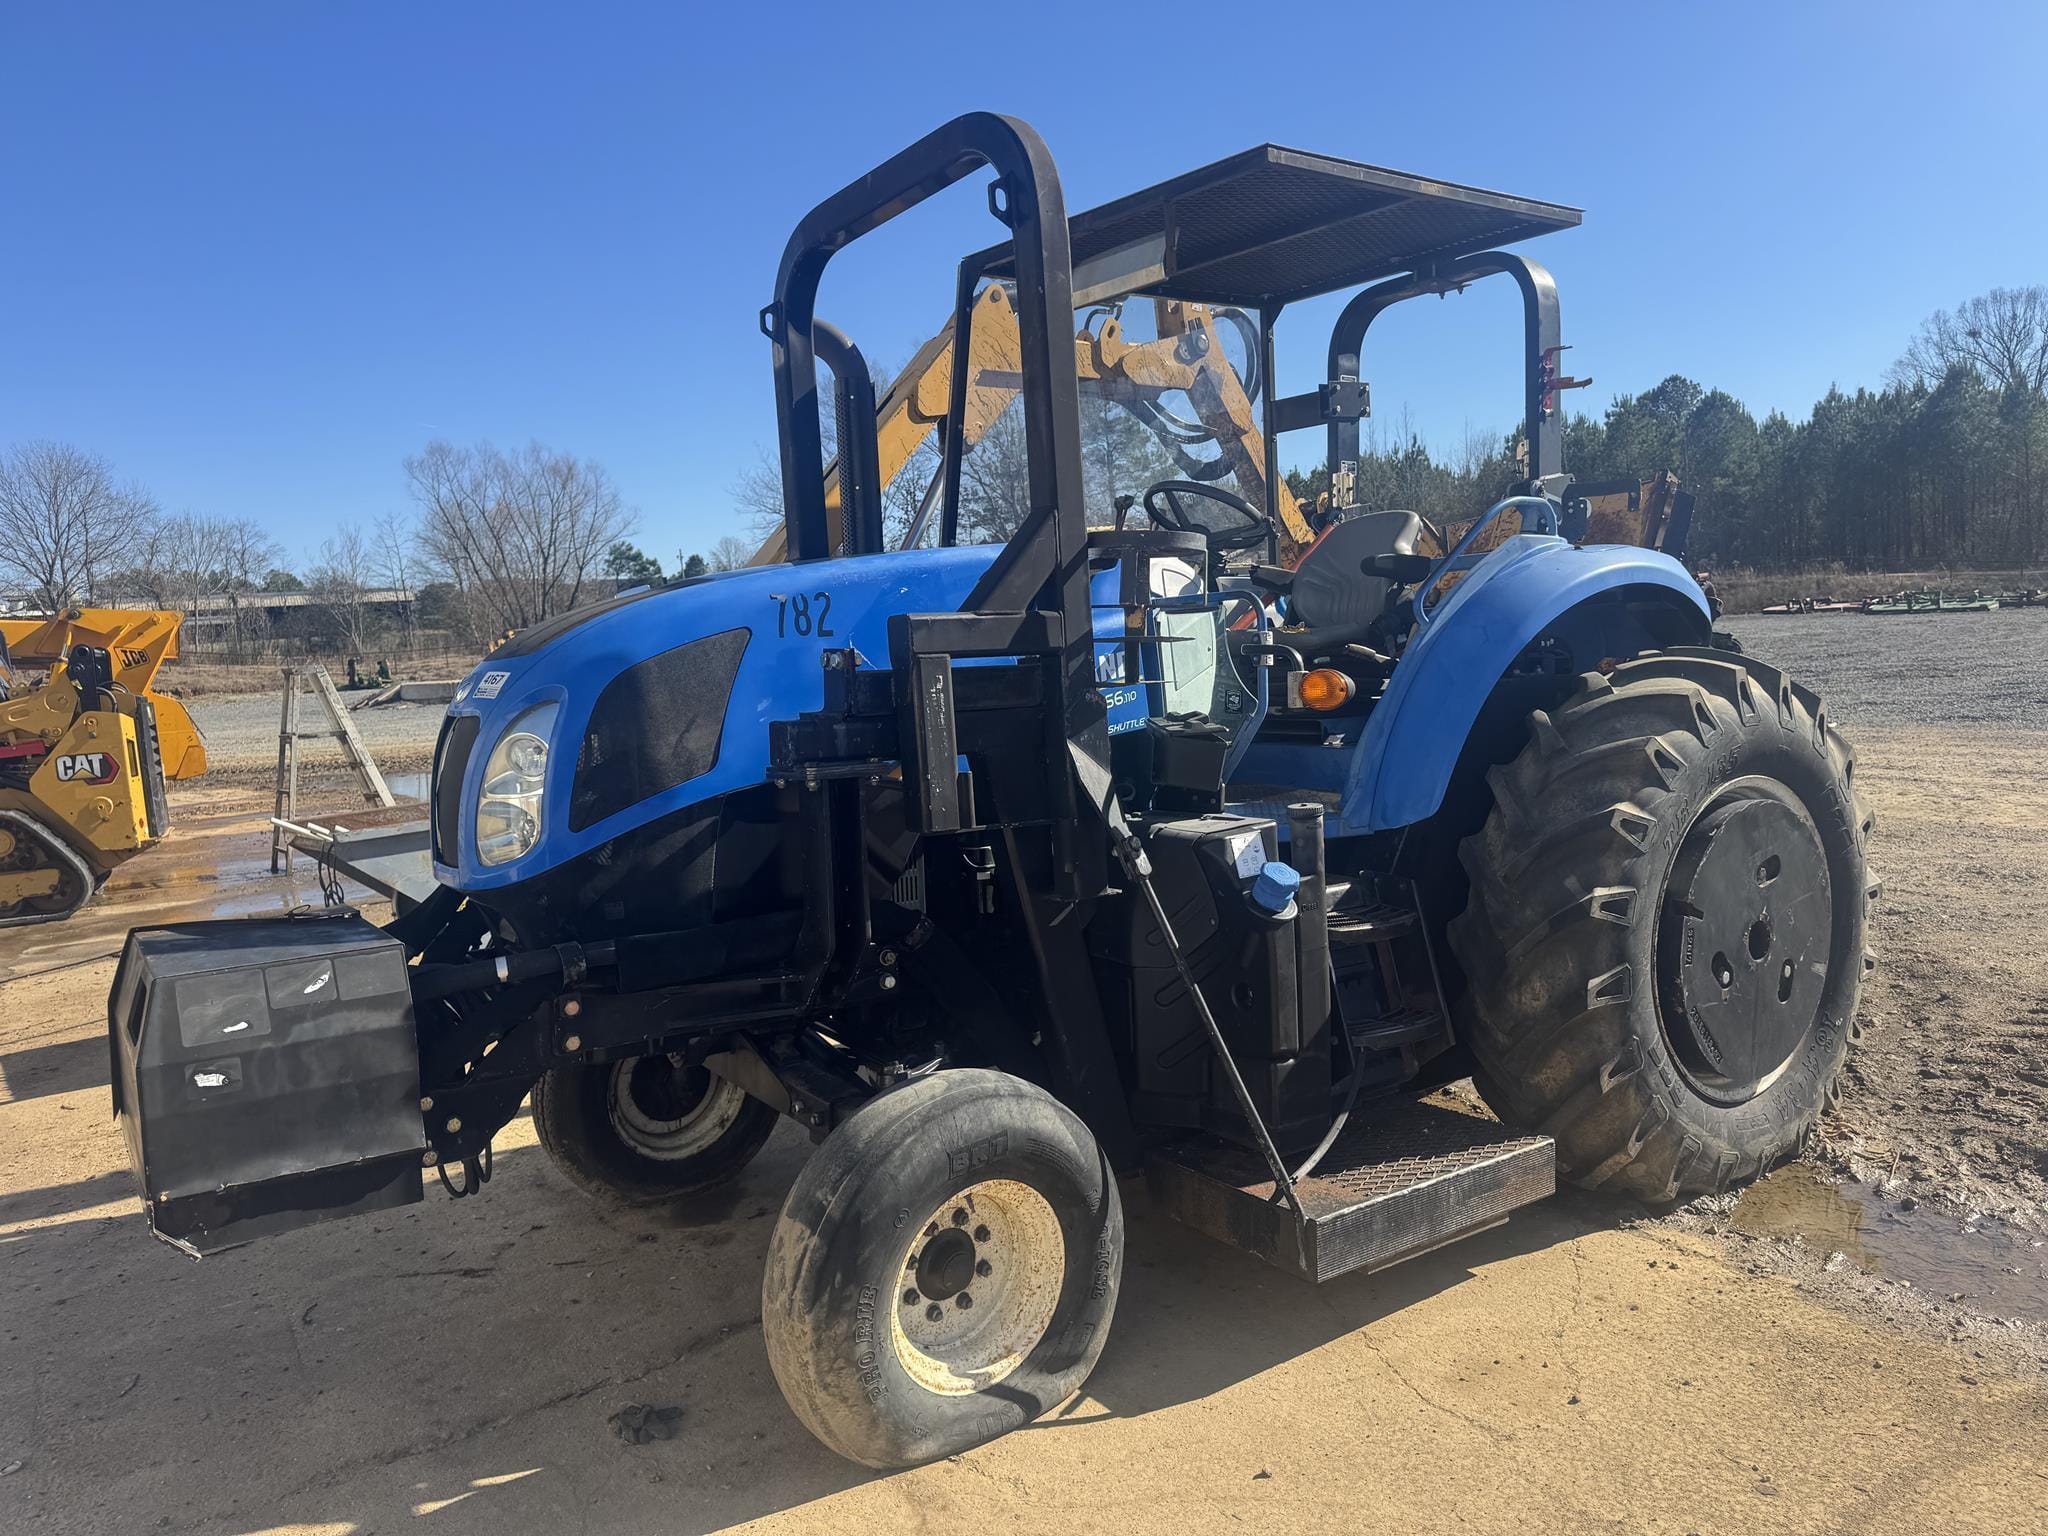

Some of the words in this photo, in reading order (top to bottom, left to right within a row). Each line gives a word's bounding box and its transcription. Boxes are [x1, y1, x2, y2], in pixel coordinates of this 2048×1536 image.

[769, 591, 834, 639] 782
[120, 649, 149, 668] JCB
[1107, 717, 1146, 734] SHUTTLE
[56, 753, 103, 780] CAT
[855, 1285, 878, 1343] RIB
[857, 1350, 890, 1404] PRO
